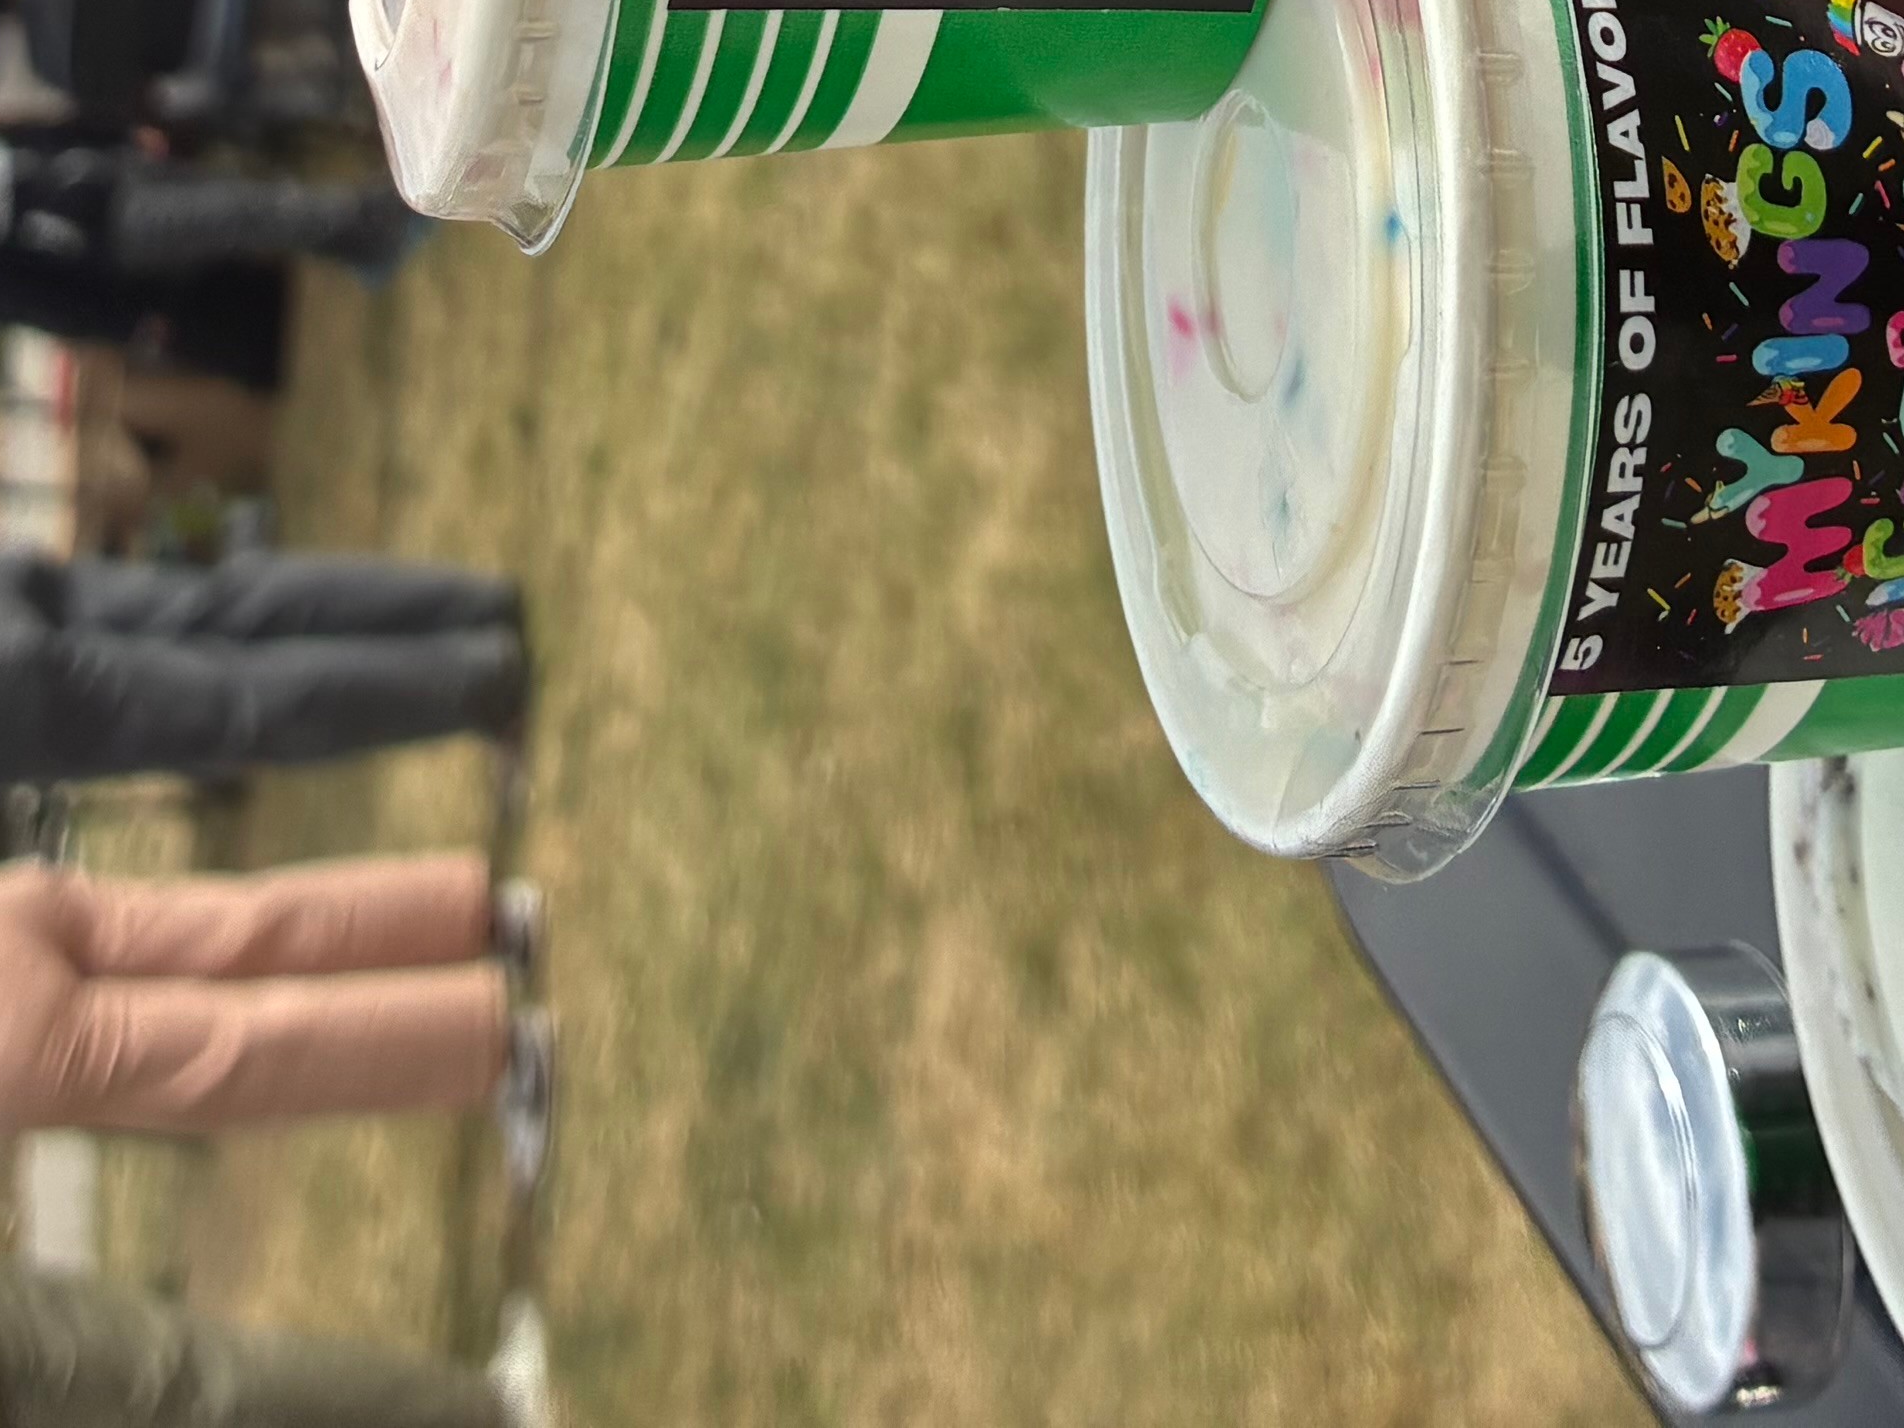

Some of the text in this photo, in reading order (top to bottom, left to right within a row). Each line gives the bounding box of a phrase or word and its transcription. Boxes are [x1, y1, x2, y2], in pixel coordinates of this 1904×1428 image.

[1618, 269, 1657, 371] OF
[1576, 391, 1653, 621] YEARS
[1560, 634, 1603, 670] 5
